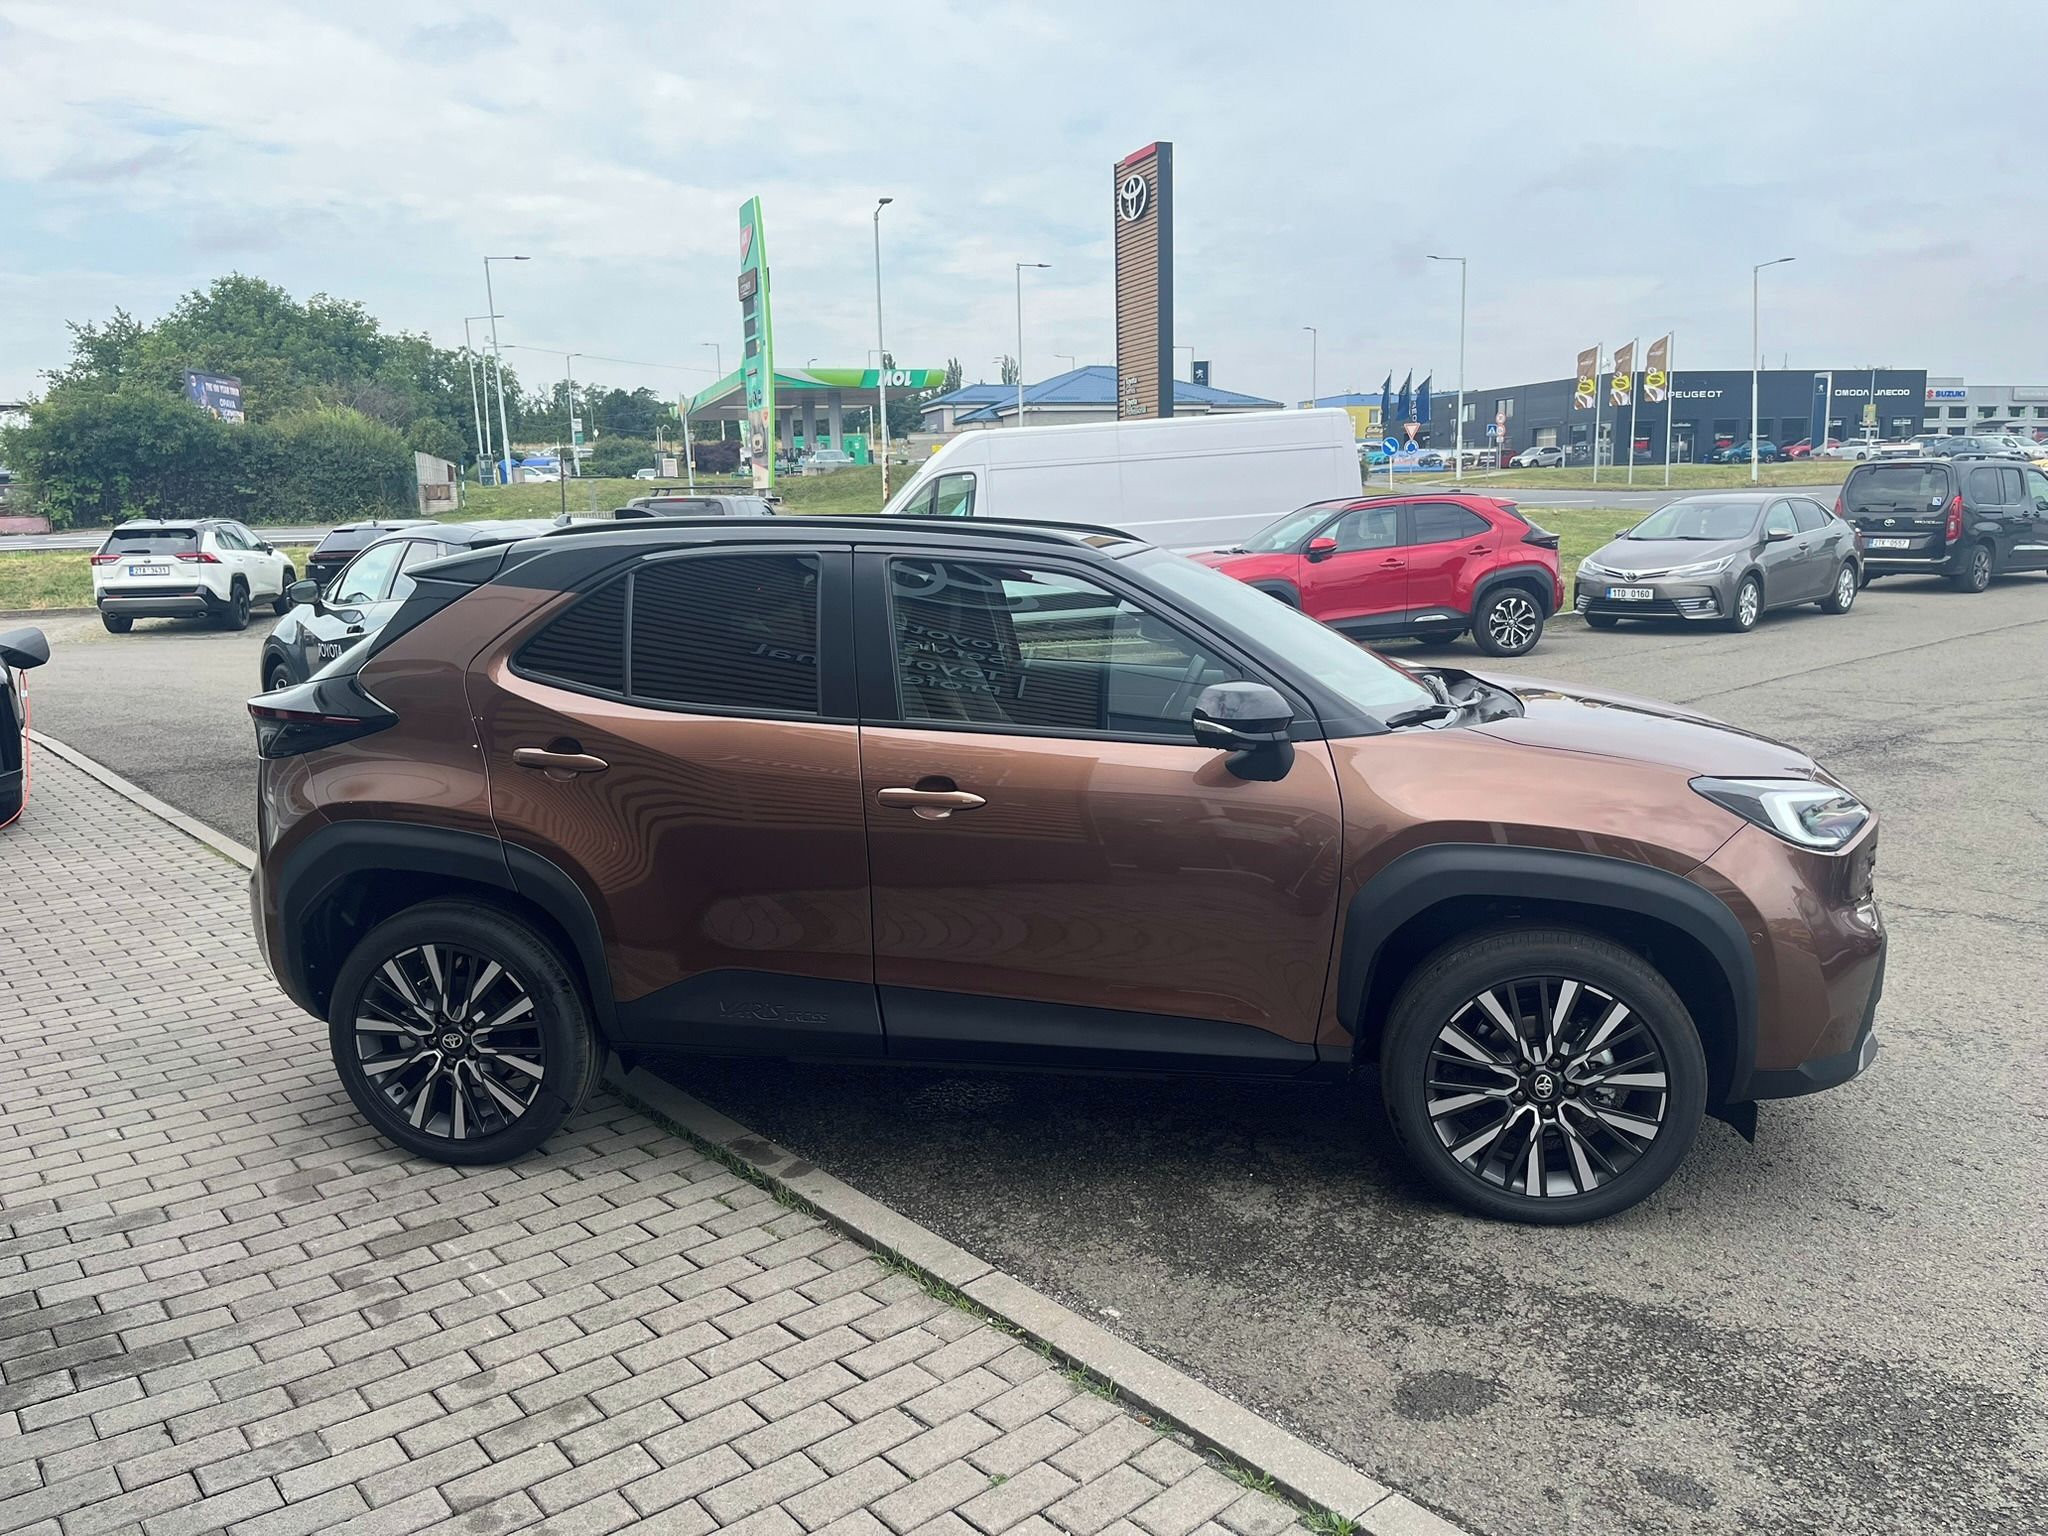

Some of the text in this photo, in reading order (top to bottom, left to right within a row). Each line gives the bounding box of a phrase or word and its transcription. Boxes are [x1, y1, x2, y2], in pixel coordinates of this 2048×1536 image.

[876, 370, 912, 386] MOL
[1668, 390, 1723, 398] PEUGEOT
[1935, 390, 1966, 398] SUZUKI
[1613, 589, 1650, 598] 1TD 0160
[318, 642, 343, 658] TOYOTA
